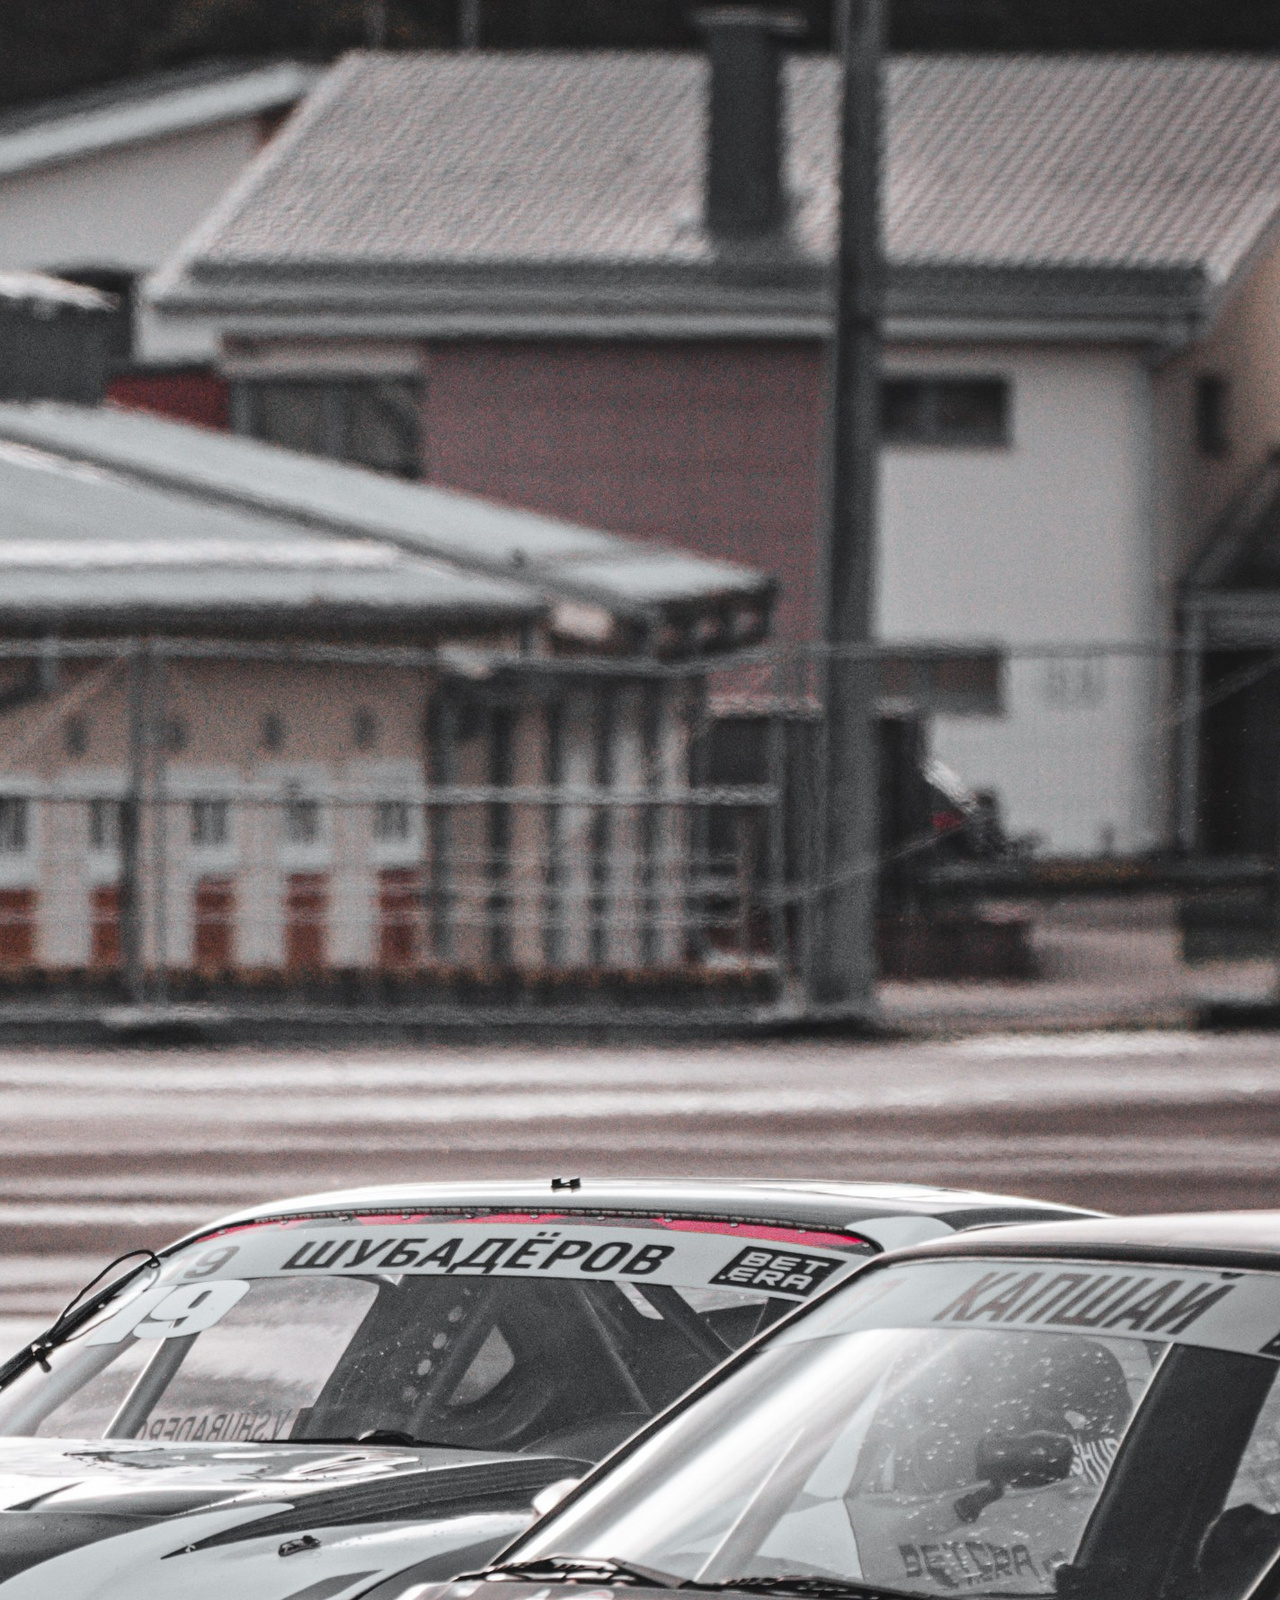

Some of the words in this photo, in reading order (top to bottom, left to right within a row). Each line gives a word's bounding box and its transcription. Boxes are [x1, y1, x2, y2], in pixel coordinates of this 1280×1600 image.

[281, 1231, 675, 1275] ШУБАДЁРОВ
[740, 1251, 830, 1275] BET
[85, 1280, 250, 1347] 19
